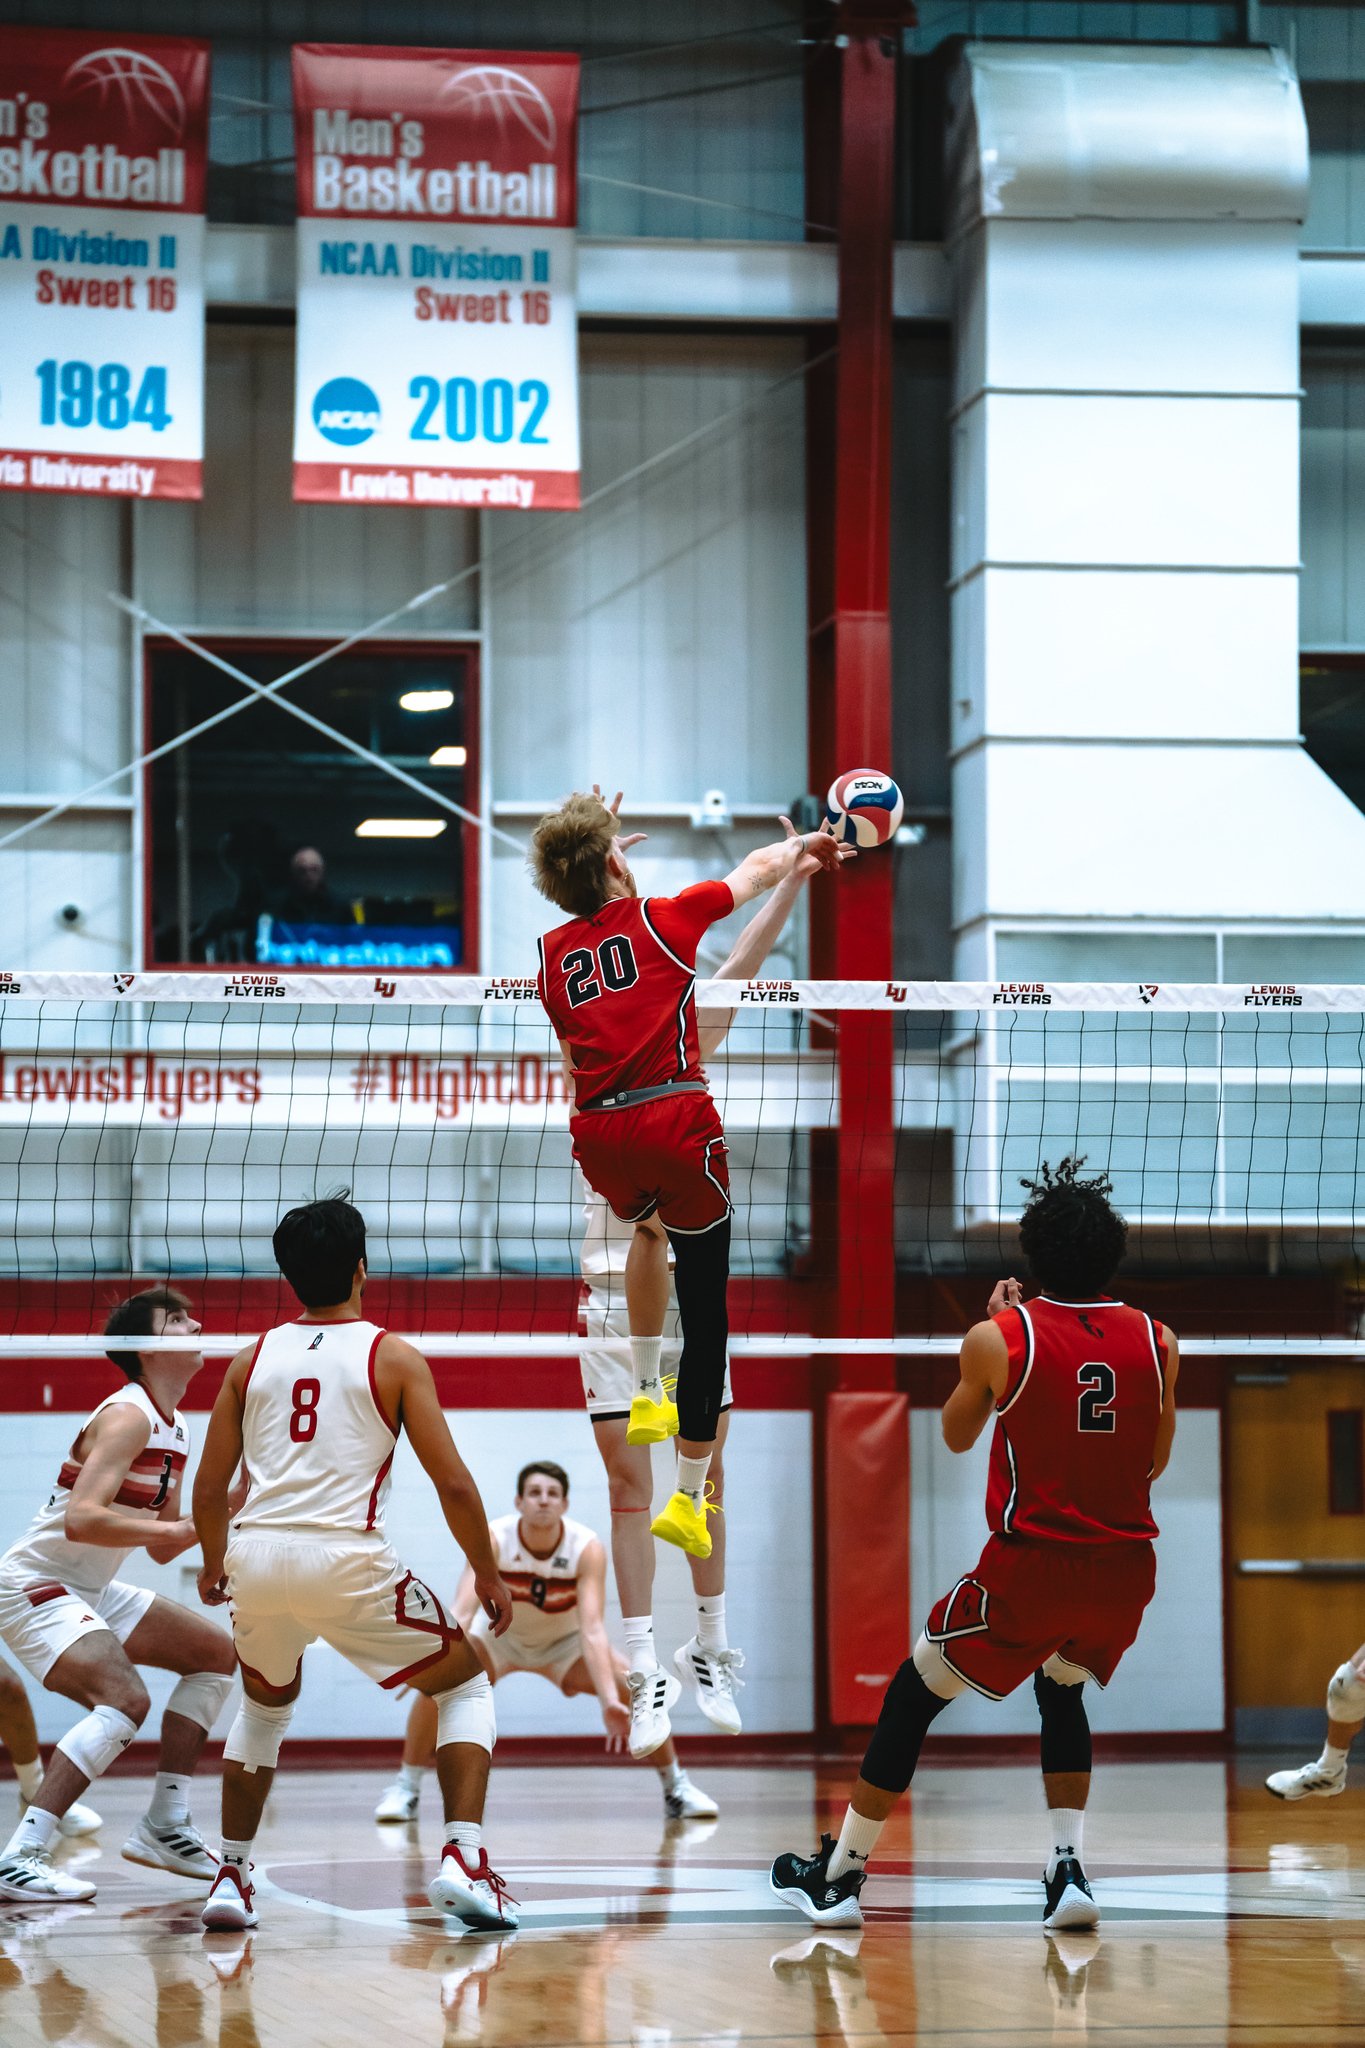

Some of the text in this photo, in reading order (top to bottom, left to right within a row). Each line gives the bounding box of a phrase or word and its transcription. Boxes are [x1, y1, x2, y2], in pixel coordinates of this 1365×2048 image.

[313, 108, 424, 158] Men's
[0, 139, 184, 205] sketball
[313, 155, 556, 219] Basketball
[0, 224, 21, 260] A
[32, 226, 149, 267] Division
[320, 241, 400, 277] NCAA
[411, 245, 523, 281] Division
[36, 269, 177, 312] Sweet 16
[415, 286, 550, 325] Sweet 16
[36, 359, 173, 432] 1984
[408, 375, 549, 444] 2002
[318, 410, 382, 431] NCAA
[31, 456, 156, 496] University
[340, 468, 535, 508] Lewis University
[232, 975, 278, 985] LEWIS
[491, 978, 537, 988] LEWIS
[561, 934, 639, 1009] 20
[747, 981, 792, 990] LEWIS
[1000, 984, 1044, 993] LEWIS
[1251, 985, 1296, 994] LEWIS
[224, 986, 286, 997] FLYERS
[484, 989, 541, 999] FLYERS
[740, 991, 800, 1002] FLYERS
[992, 993, 1051, 1005] FLYERS
[1244, 995, 1303, 1006] FLYERS
[290, 1378, 321, 1443] 8
[1077, 1362, 1116, 1433] 2
[531, 1577, 547, 1609] 9
